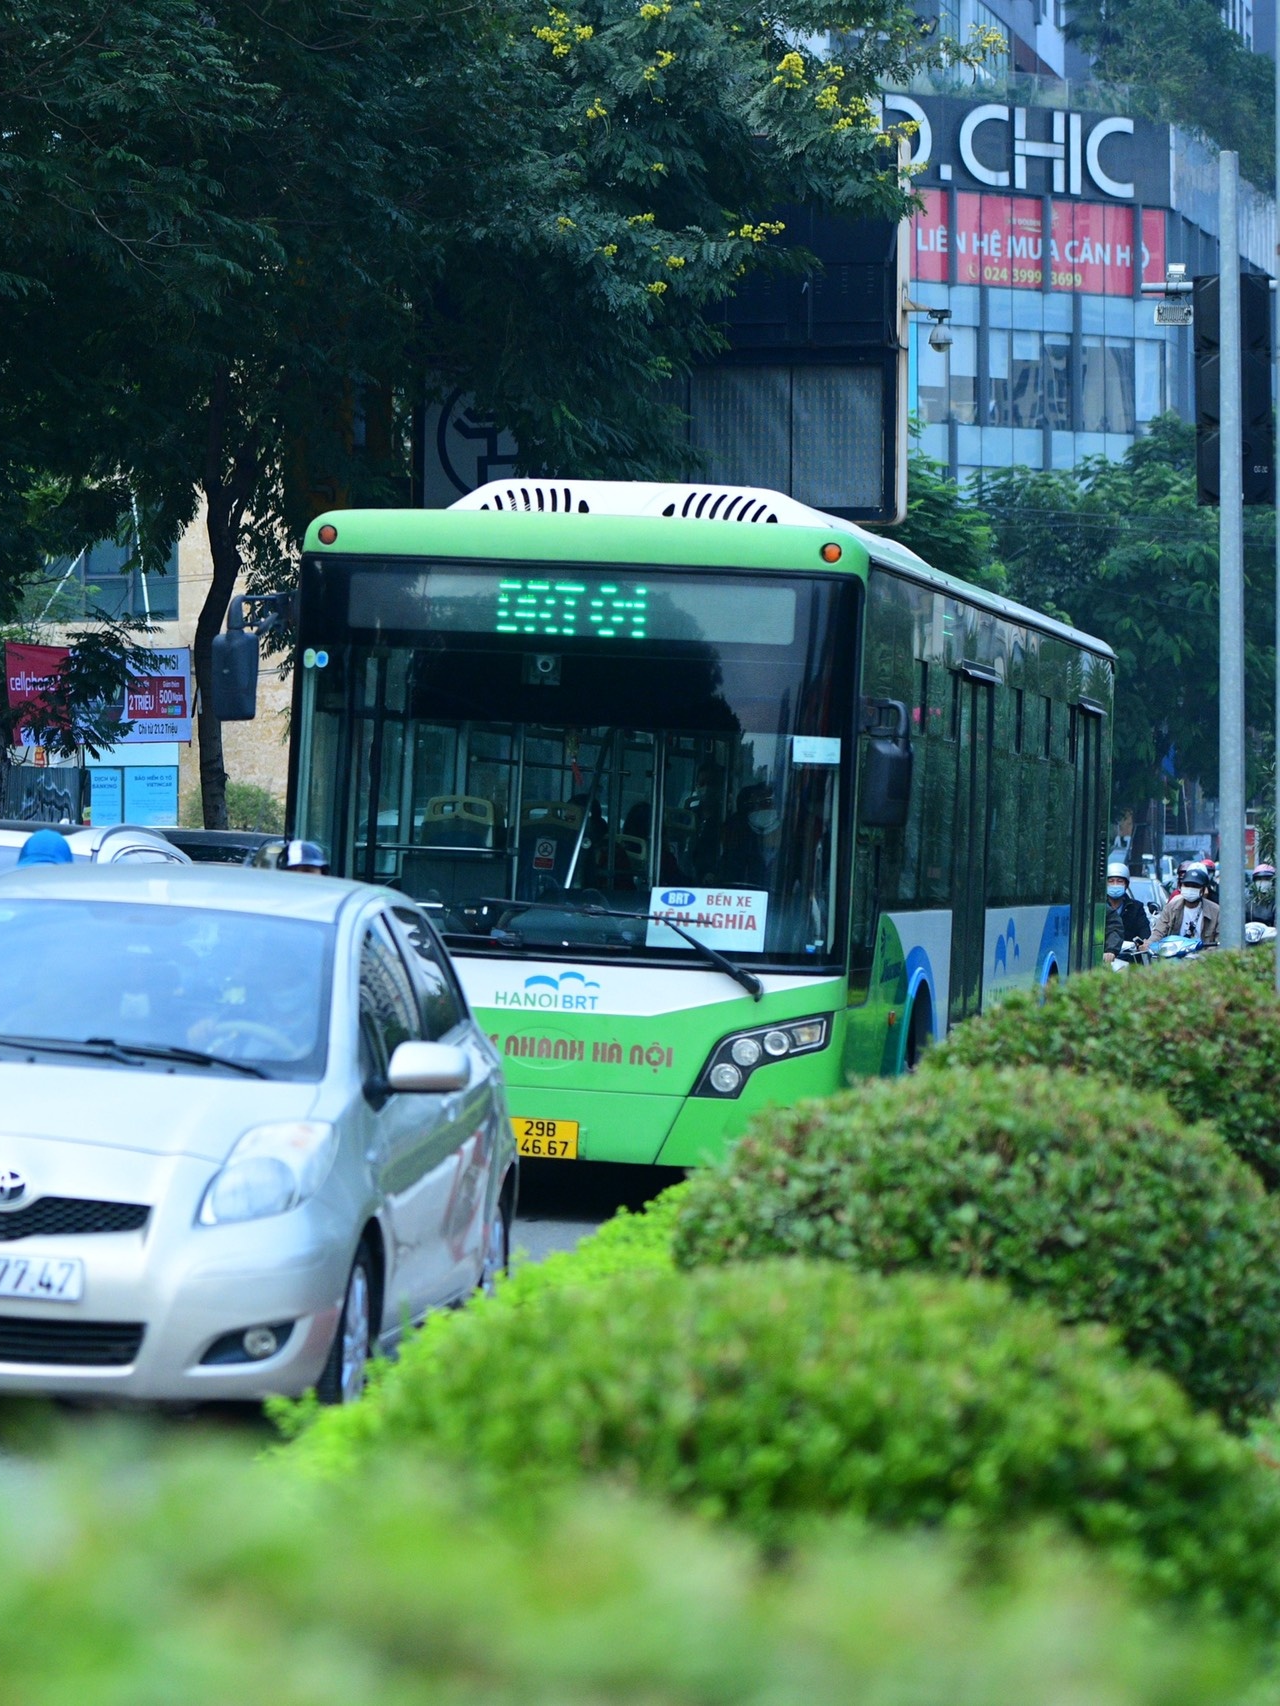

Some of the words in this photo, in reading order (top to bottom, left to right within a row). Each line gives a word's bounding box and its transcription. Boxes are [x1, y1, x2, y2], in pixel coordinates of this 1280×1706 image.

[917, 225, 967, 254] LIÊN
[973, 229, 1001, 263] HỆ
[1008, 235, 1060, 261] MUA
[1065, 236, 1110, 267] CĂN
[984, 267, 1008, 282] 024
[1012, 269, 1041, 284] 3999
[1051, 271, 1082, 287] 3699
[129, 695, 134, 711] 2
[159, 690, 172, 704] 500
[668, 891, 690, 905] BRT
[706, 891, 732, 907] BẾN
[736, 896, 752, 908] XE
[653, 908, 690, 928] YÊN
[696, 910, 757, 931] NGHĨA
[592, 1037, 622, 1064] HÀ
[629, 1041, 673, 1074] NỘI
[524, 1120, 556, 1137] 29B
[515, 1138, 568, 1157] 46.67
